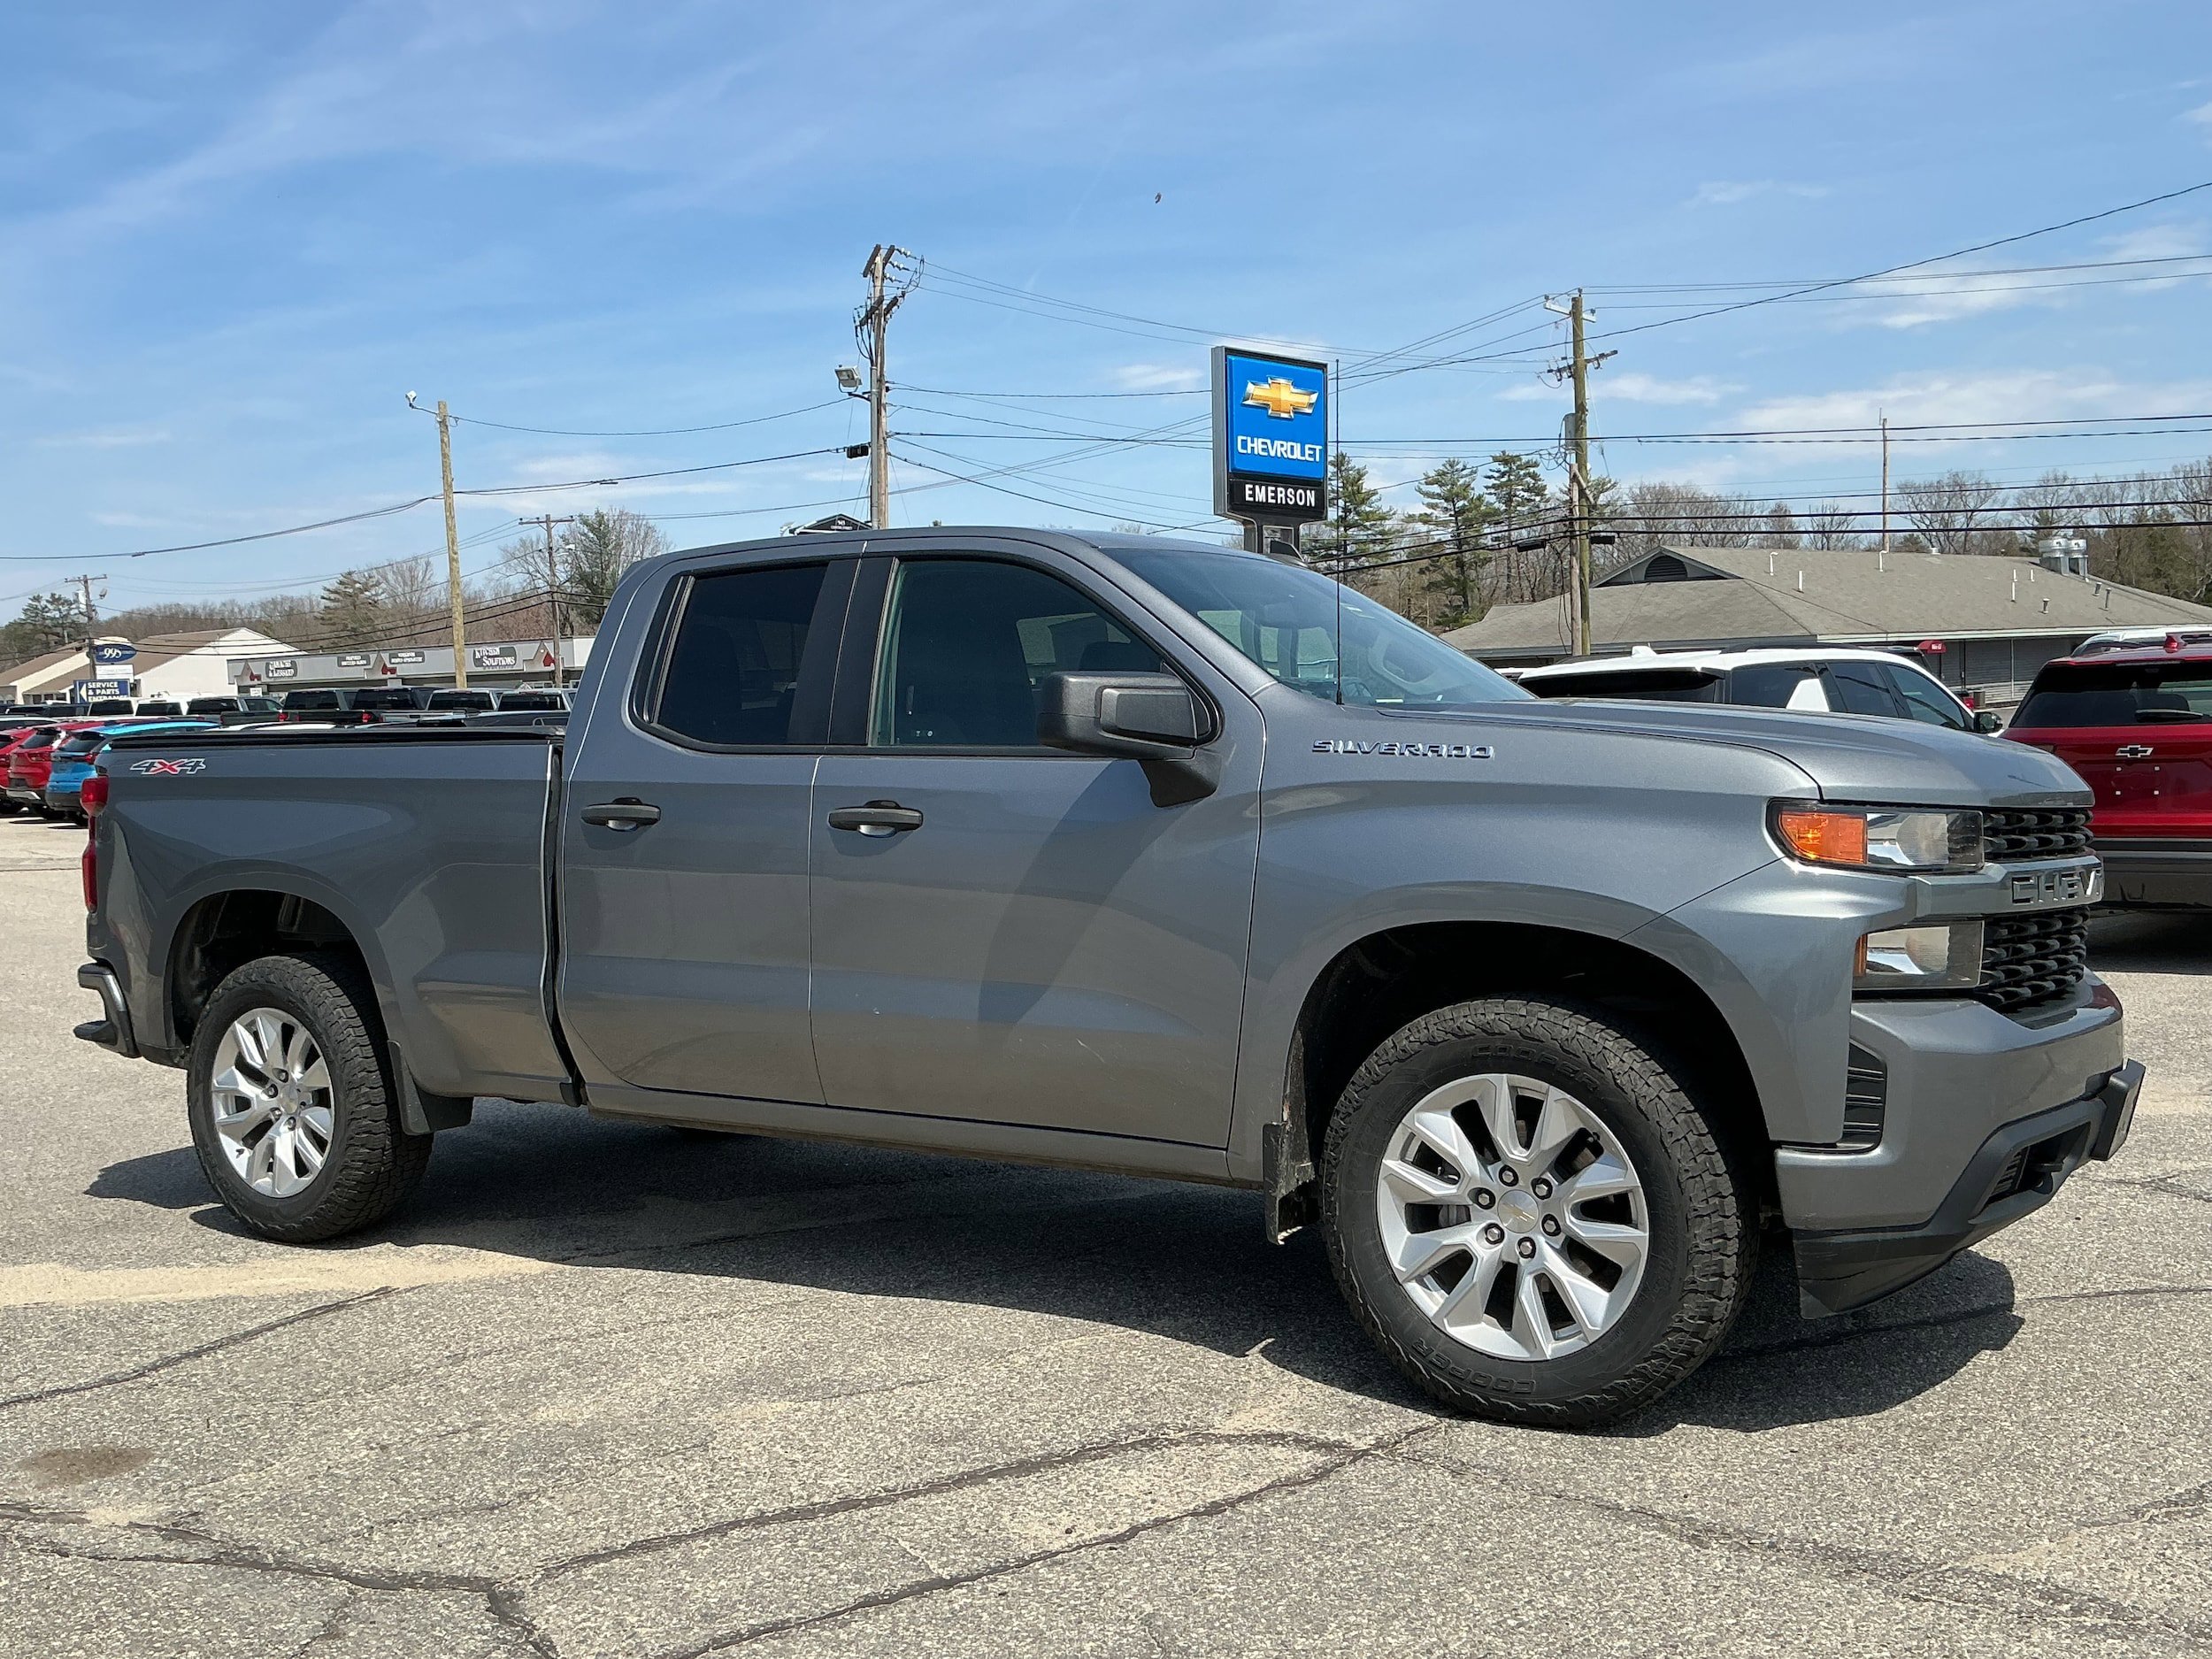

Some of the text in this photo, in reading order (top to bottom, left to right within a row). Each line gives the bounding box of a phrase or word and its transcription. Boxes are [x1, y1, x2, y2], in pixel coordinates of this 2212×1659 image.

[1237, 435, 1323, 462] CHEVROLET
[1245, 484, 1316, 507] EMERSON
[482, 657, 516, 666] SOLUTIONS
[1312, 740, 1495, 759] SILVERADO
[1471, 1044, 1600, 1091] COOPER
[1412, 1337, 1537, 1394] COOPER
